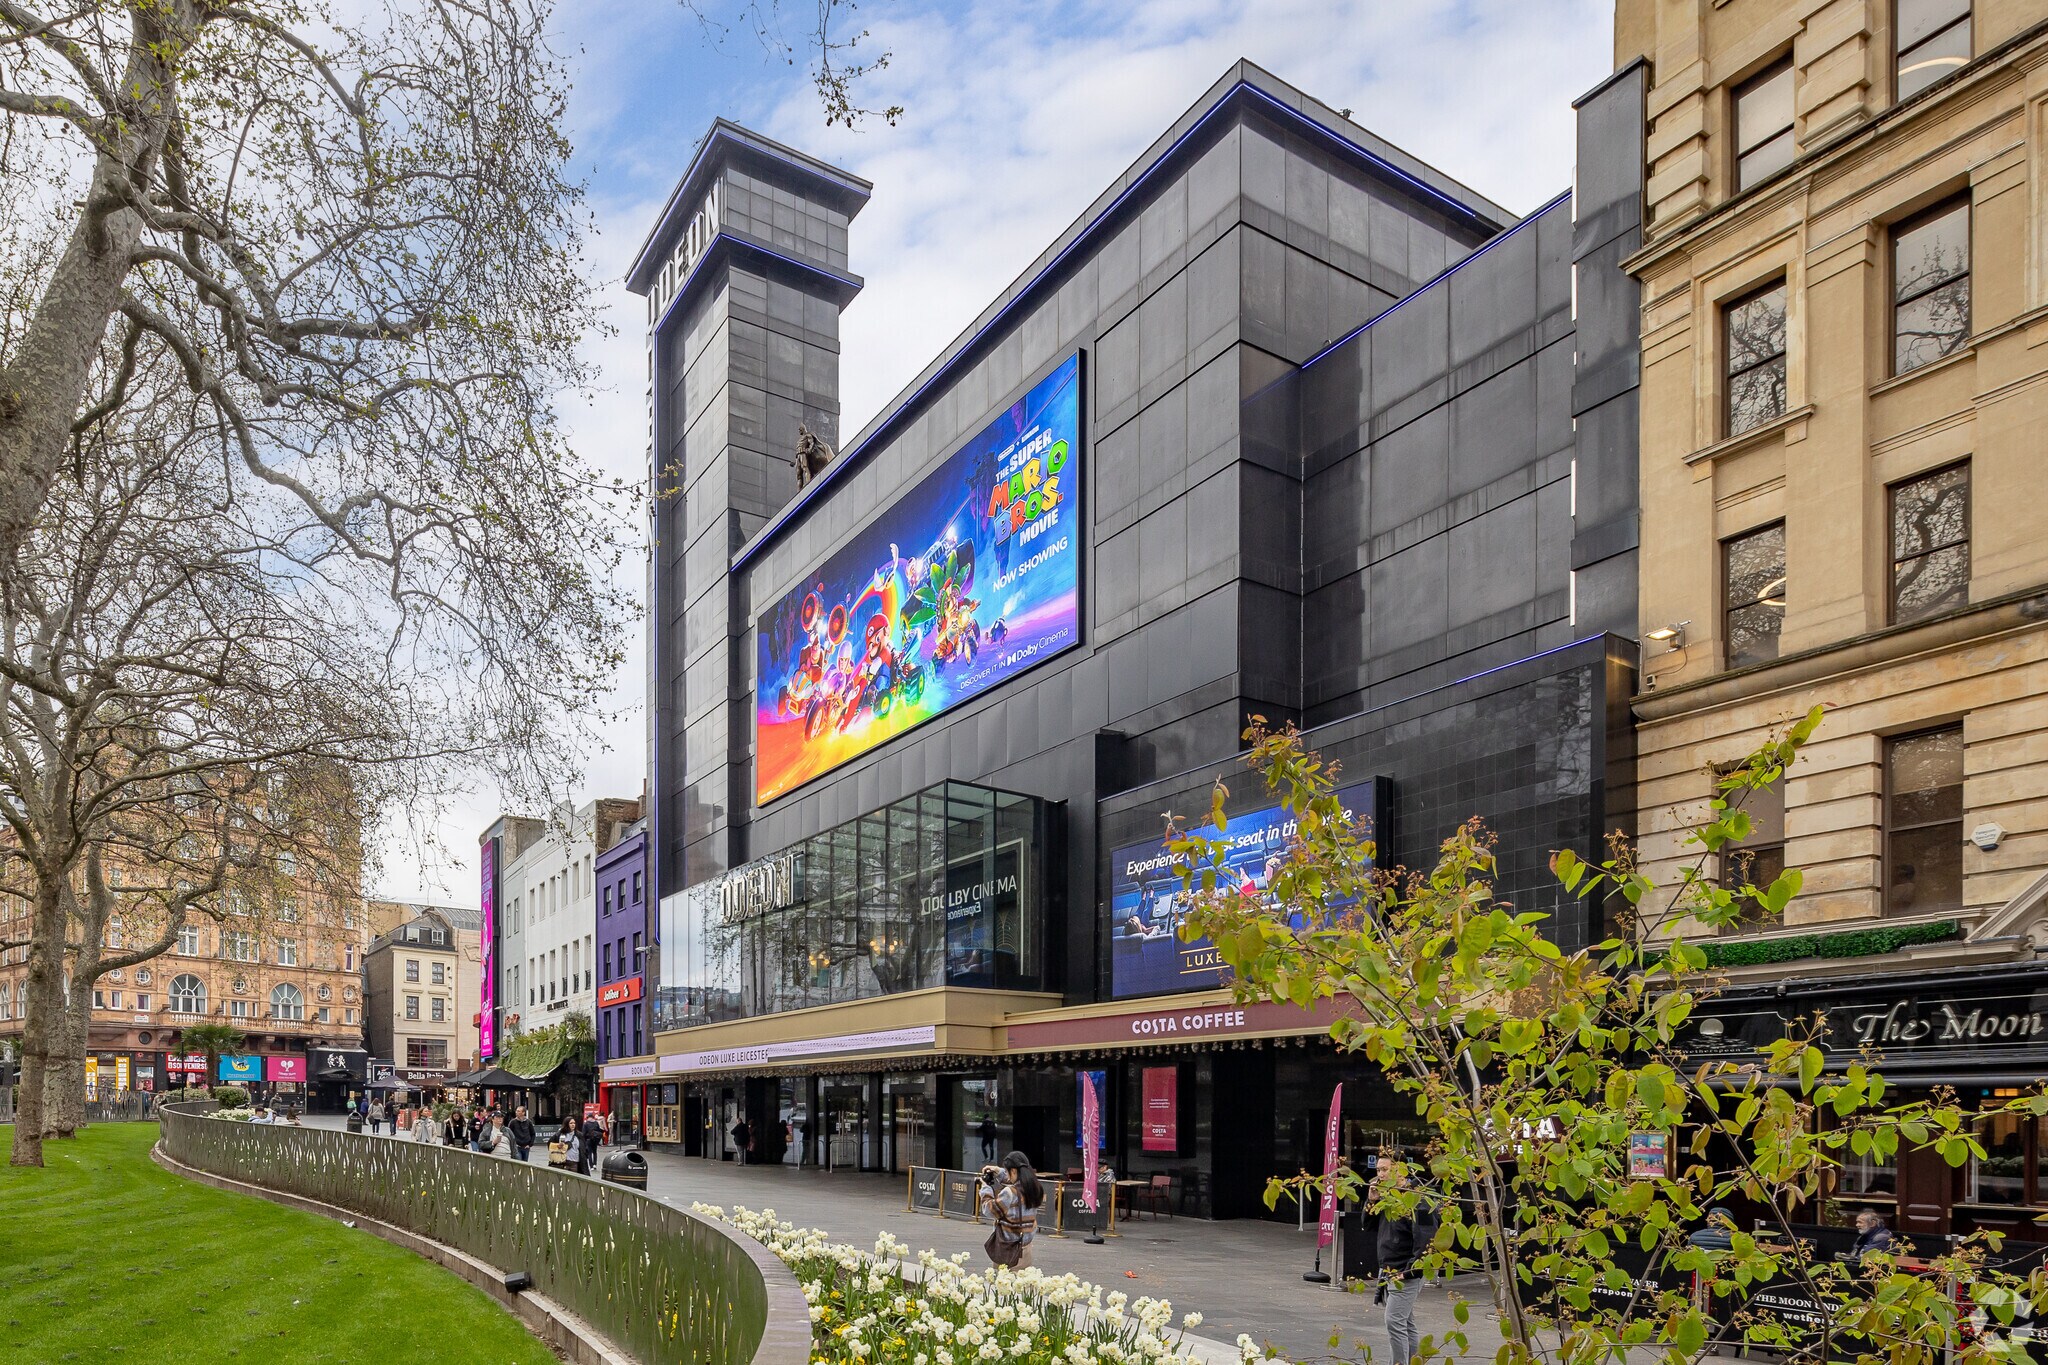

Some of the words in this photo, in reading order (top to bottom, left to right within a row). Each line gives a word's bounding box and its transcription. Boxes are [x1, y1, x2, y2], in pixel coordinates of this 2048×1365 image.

[995, 465, 1010, 482] THE
[1009, 427, 1053, 473] SUPER
[987, 438, 1069, 518] MARIO
[993, 475, 1064, 546] BROS.
[1019, 508, 1059, 547] MOVIE
[992, 567, 1017, 593] NOW
[1018, 535, 1068, 577] SHOWING
[960, 667, 991, 690] DISCOVER
[991, 663, 998, 673] IT
[998, 659, 1006, 670] IN
[1017, 642, 1039, 662] Dolby
[1038, 627, 1069, 648] Cinema
[1236, 828, 1265, 848] seat
[1266, 824, 1280, 841] in
[1282, 819, 1298, 837] th
[720, 854, 794, 925] ODEON
[1186, 948, 1223, 968] LUXE
[1131, 1016, 1177, 1035] COSTA
[1182, 1010, 1245, 1031] COFFEE
[1853, 998, 1931, 1043] The
[1938, 1003, 2045, 1040] Moon
[407, 1071, 426, 1080] Bella
[631, 1066, 643, 1075] BOOK
[643, 1065, 654, 1074] NOW
[699, 1054, 719, 1066] ODEON
[720, 1052, 735, 1063] LUXE
[918, 1181, 936, 1192] COSTA
[1755, 1293, 1778, 1305] THE
[1778, 1296, 1812, 1309] MOON
